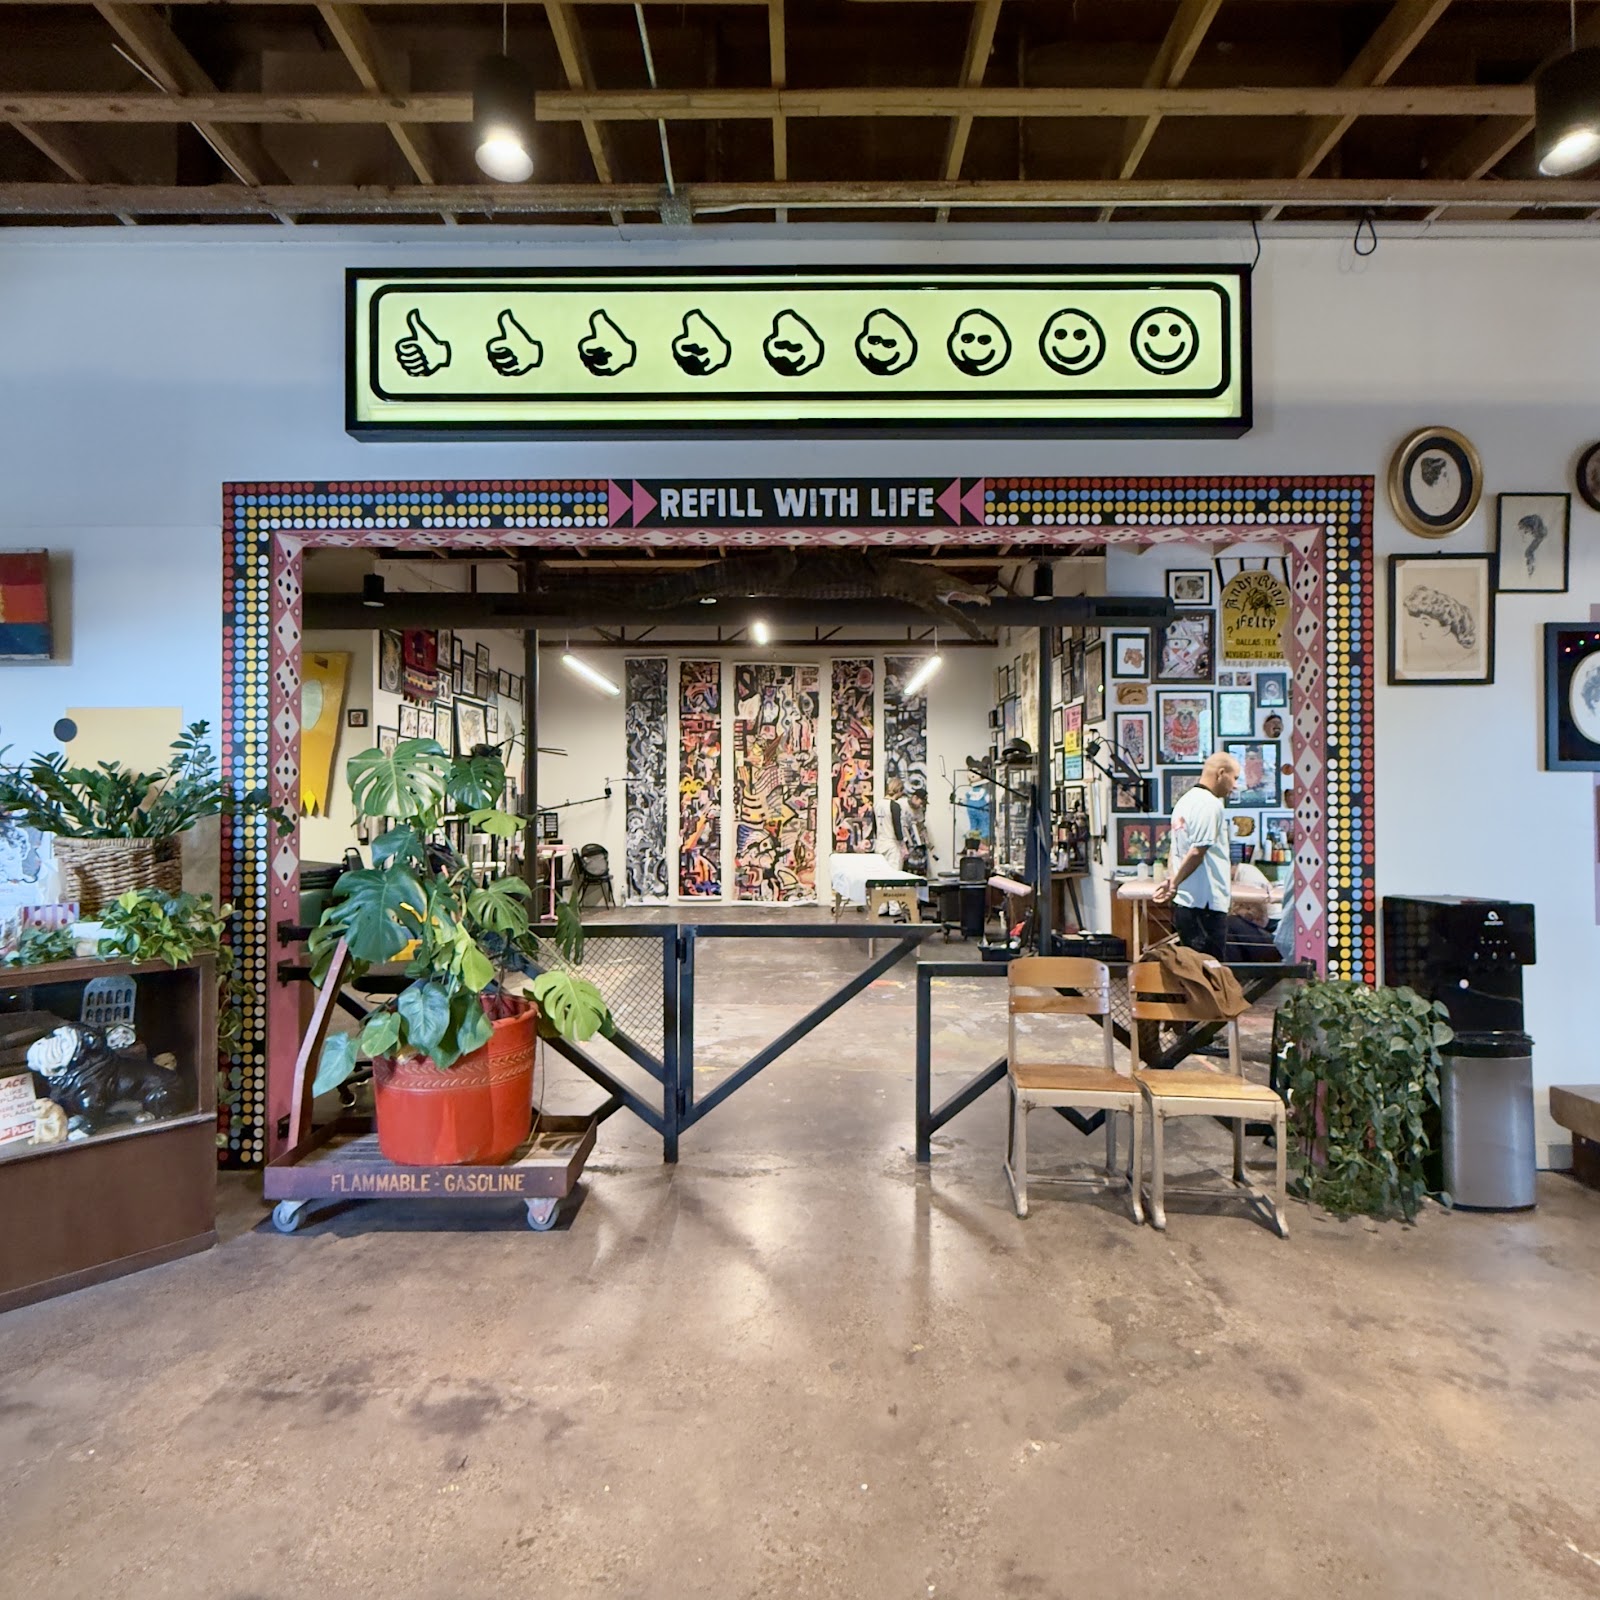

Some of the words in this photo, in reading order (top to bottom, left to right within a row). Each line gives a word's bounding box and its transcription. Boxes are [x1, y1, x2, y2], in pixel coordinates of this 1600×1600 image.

[660, 488, 763, 519] REFILL
[773, 488, 858, 517] WITH
[870, 488, 934, 517] LIFE
[331, 1173, 431, 1192] FLAMMABLE
[444, 1173, 525, 1191] GASOLINE
